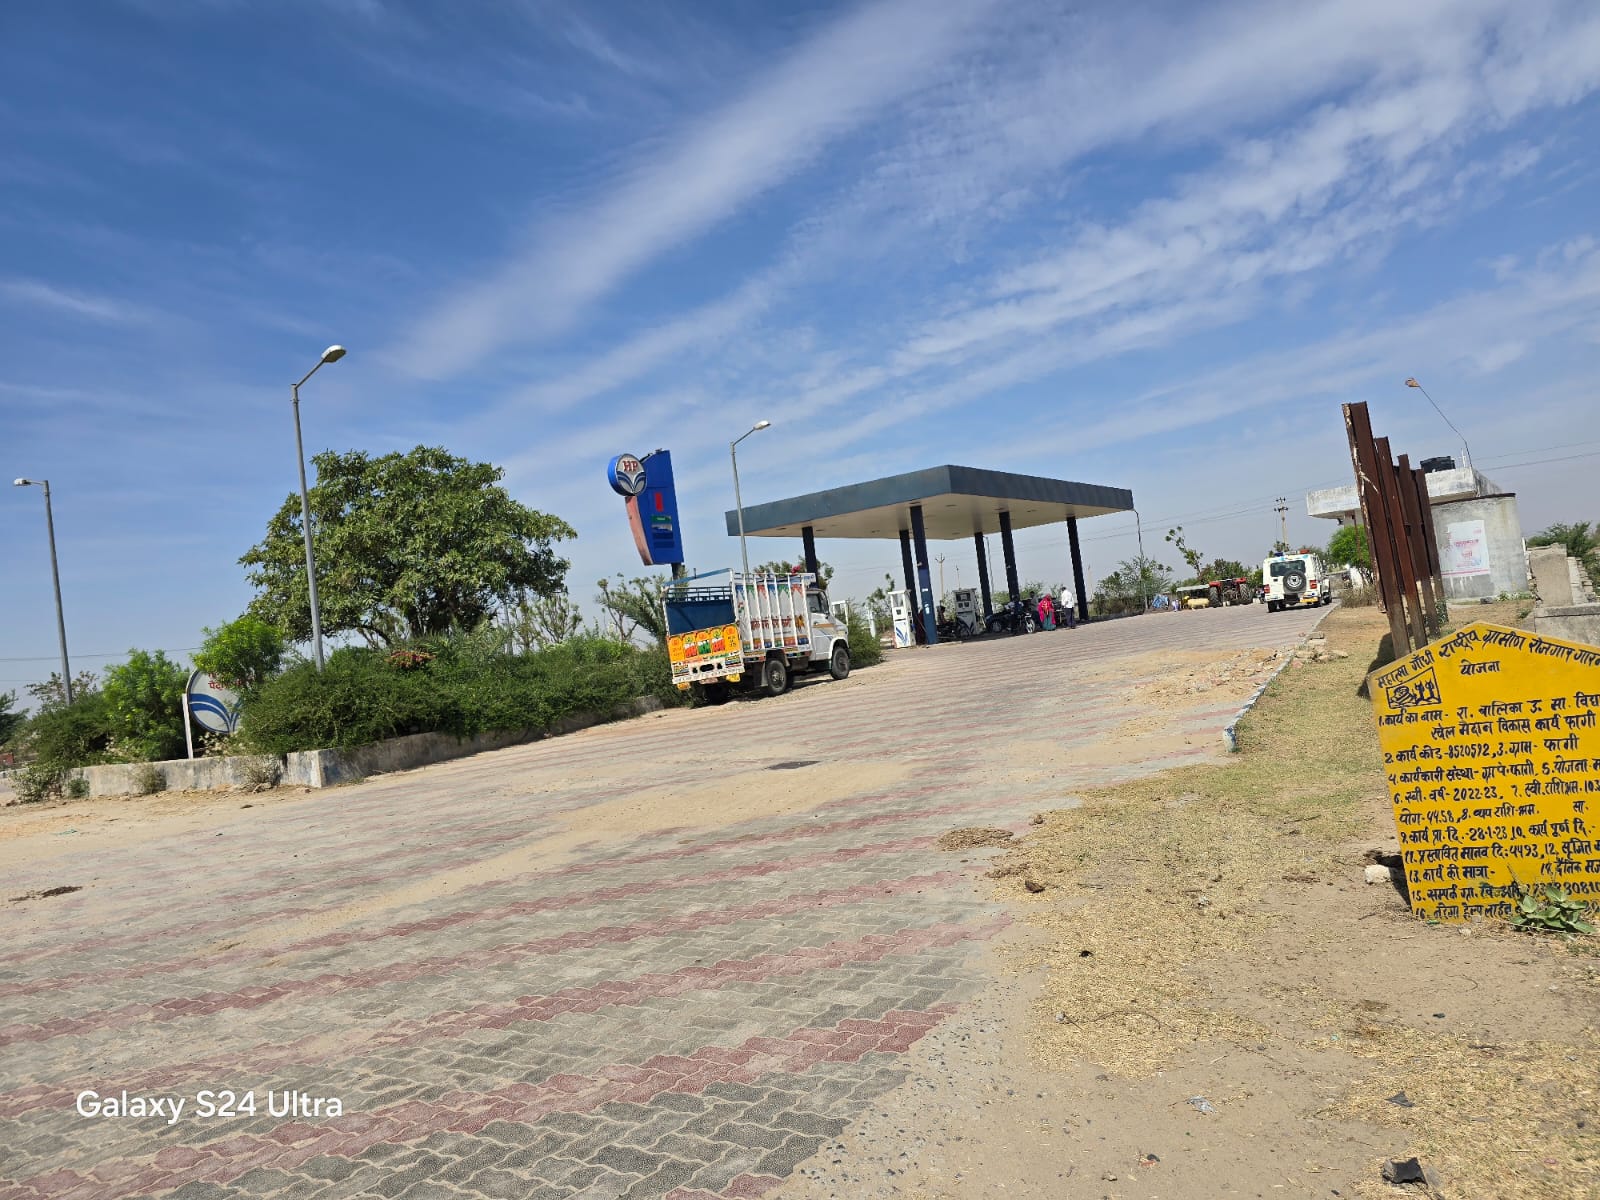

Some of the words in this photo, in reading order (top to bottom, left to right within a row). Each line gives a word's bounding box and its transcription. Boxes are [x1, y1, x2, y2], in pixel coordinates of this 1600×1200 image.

[622, 460, 638, 472] HP
[1459, 659, 1500, 675] योजना
[1479, 701, 1523, 717] बालिका
[1497, 718, 1532, 733] विकास
[1563, 710, 1596, 729] फागी
[1544, 733, 1580, 751] फागी
